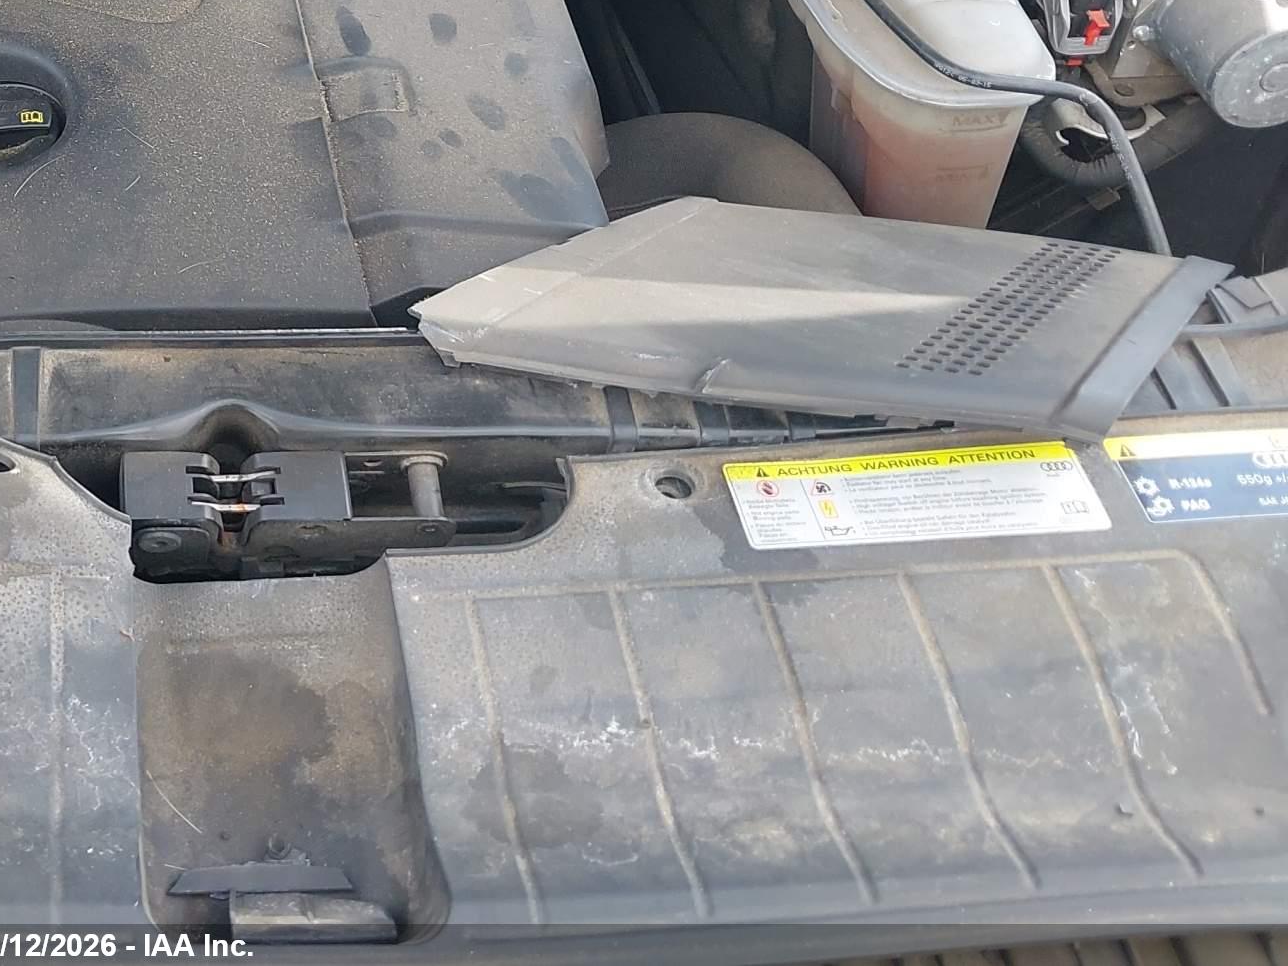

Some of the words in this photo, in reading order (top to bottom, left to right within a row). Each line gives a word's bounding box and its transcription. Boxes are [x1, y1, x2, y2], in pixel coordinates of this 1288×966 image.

[777, 463, 852, 477] ACHTUNG
[861, 456, 939, 471] WARNING
[948, 449, 1035, 464] ATTENTION
